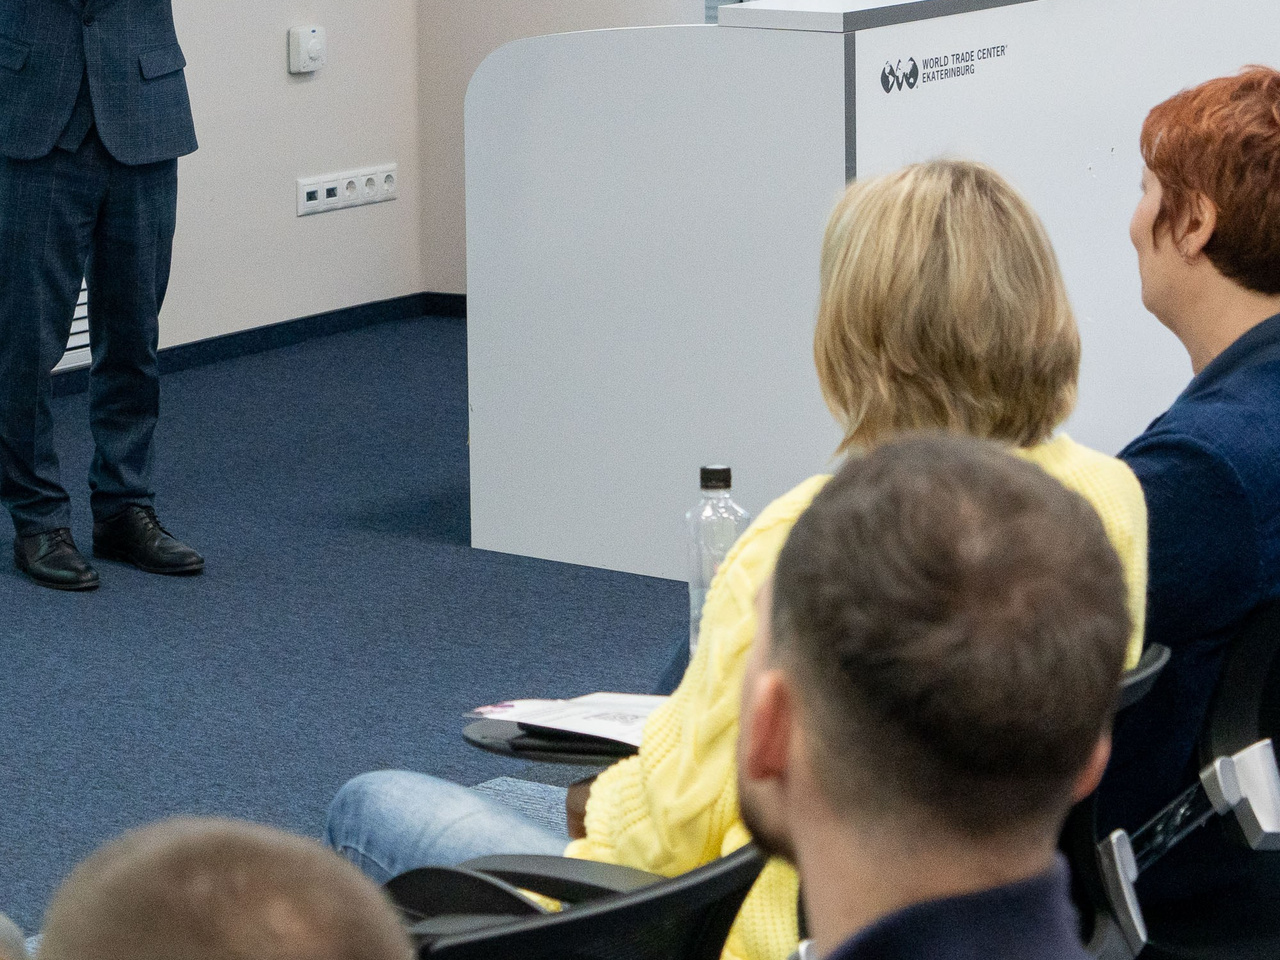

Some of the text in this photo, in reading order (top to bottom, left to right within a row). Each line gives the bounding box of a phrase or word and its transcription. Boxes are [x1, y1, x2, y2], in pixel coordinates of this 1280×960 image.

[922, 45, 1006, 70] WORLD TRADE CENTER
[922, 64, 975, 83] EKATERINBURG
